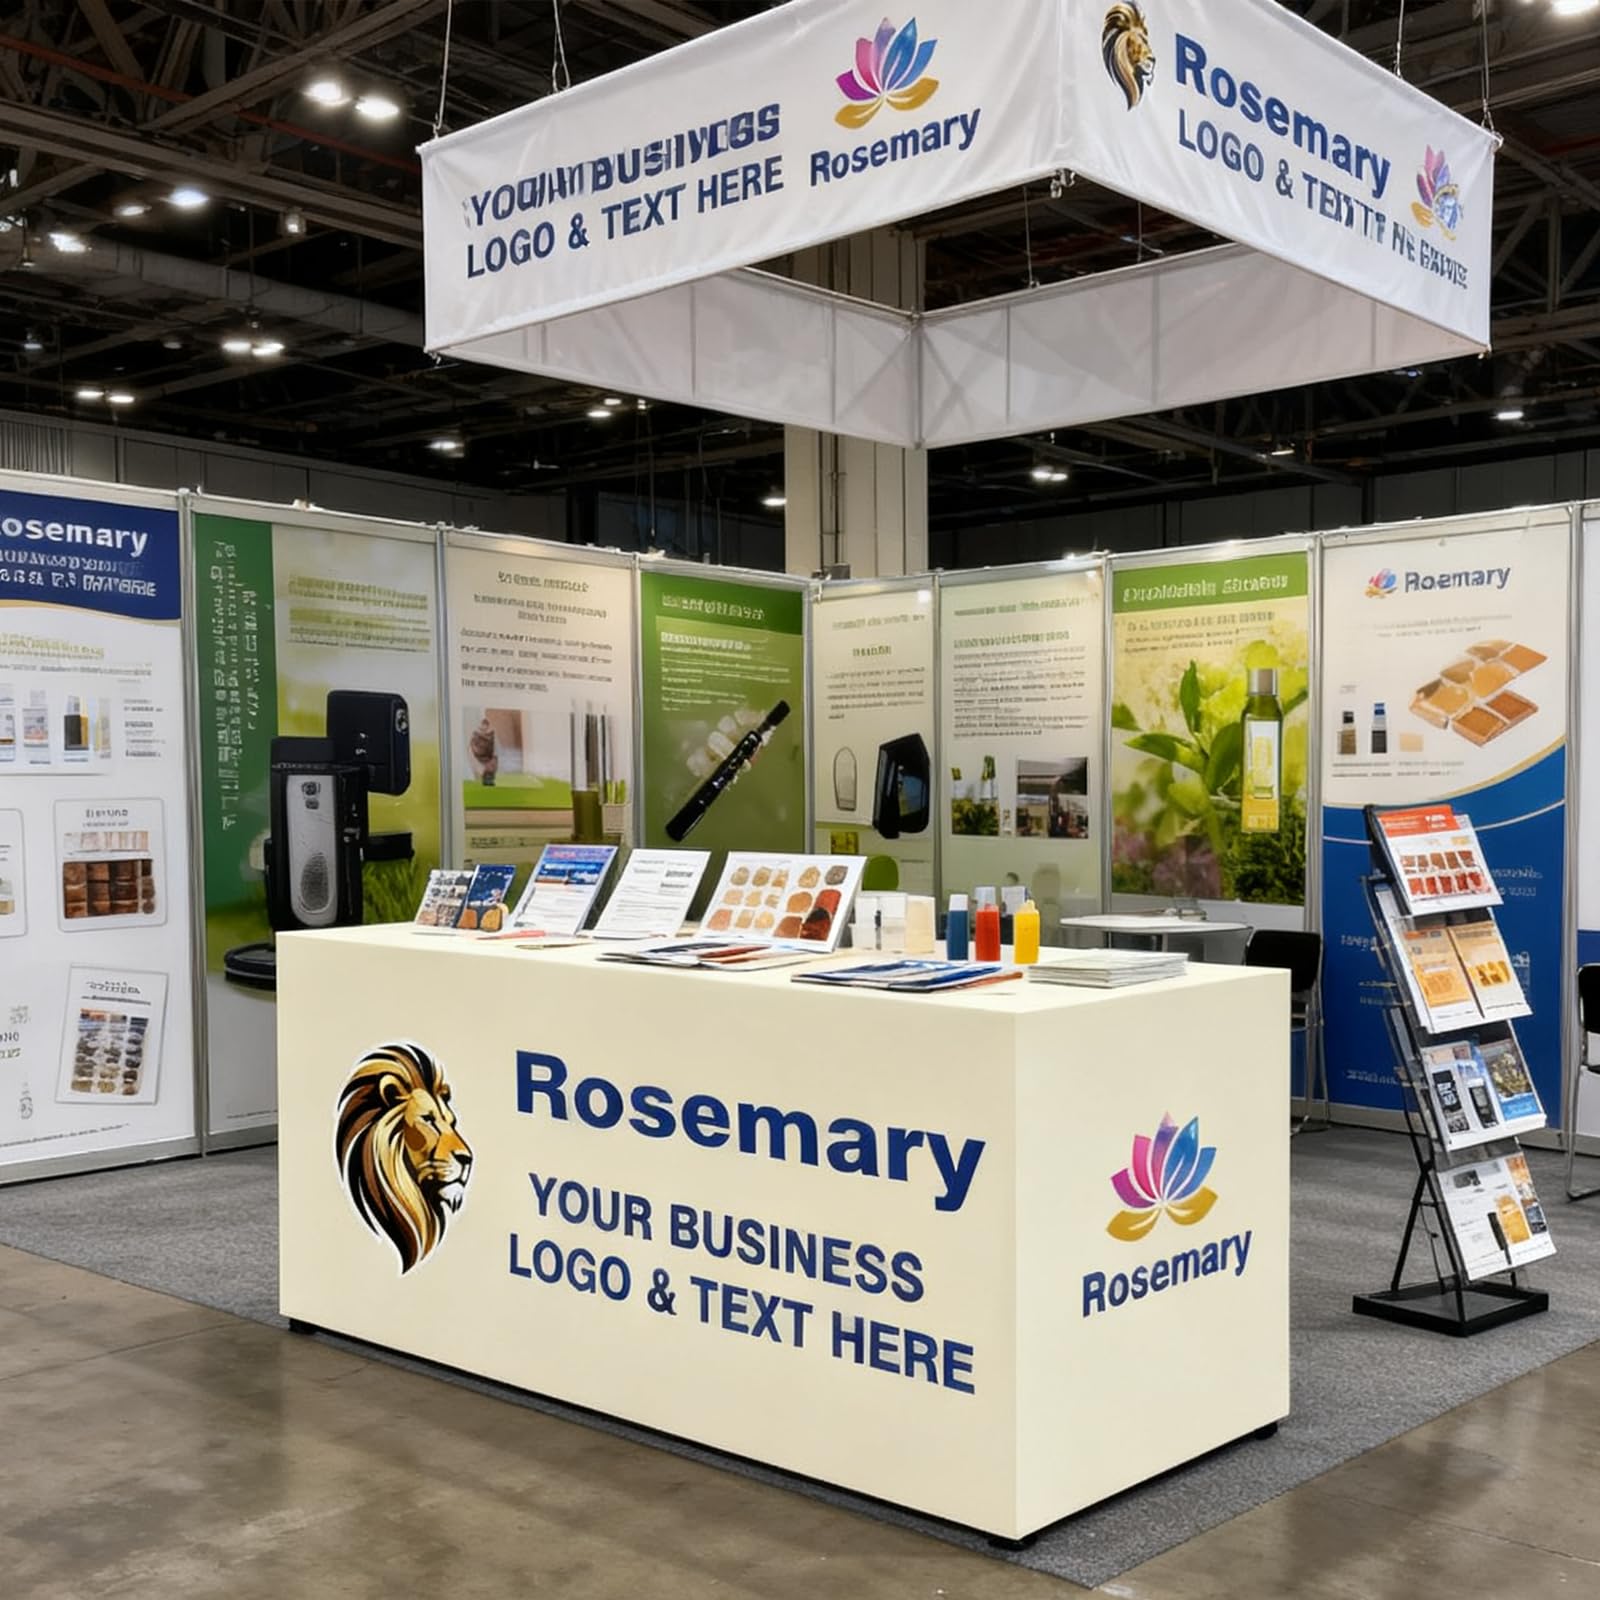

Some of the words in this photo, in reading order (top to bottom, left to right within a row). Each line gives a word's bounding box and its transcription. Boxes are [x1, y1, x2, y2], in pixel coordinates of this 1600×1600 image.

[810, 107, 981, 188] Rosemary
[1175, 32, 1391, 200] Rosemary
[1178, 108, 1265, 183] LOGO
[1275, 158, 1294, 200] &
[467, 222, 556, 279] LOGO
[568, 212, 590, 250] &
[600, 183, 687, 240] TEXT
[698, 155, 785, 214] HERE
[0, 517, 148, 558] osemary
[515, 1050, 987, 1213] Rosemary
[529, 1172, 653, 1241] YOUR
[670, 1203, 925, 1304] BUSINESS
[1082, 1229, 1253, 1319] Rosemary
[509, 1232, 632, 1302] LOGO
[646, 1267, 678, 1316] &
[689, 1275, 814, 1349] TEXT
[831, 1310, 976, 1396] HERE
